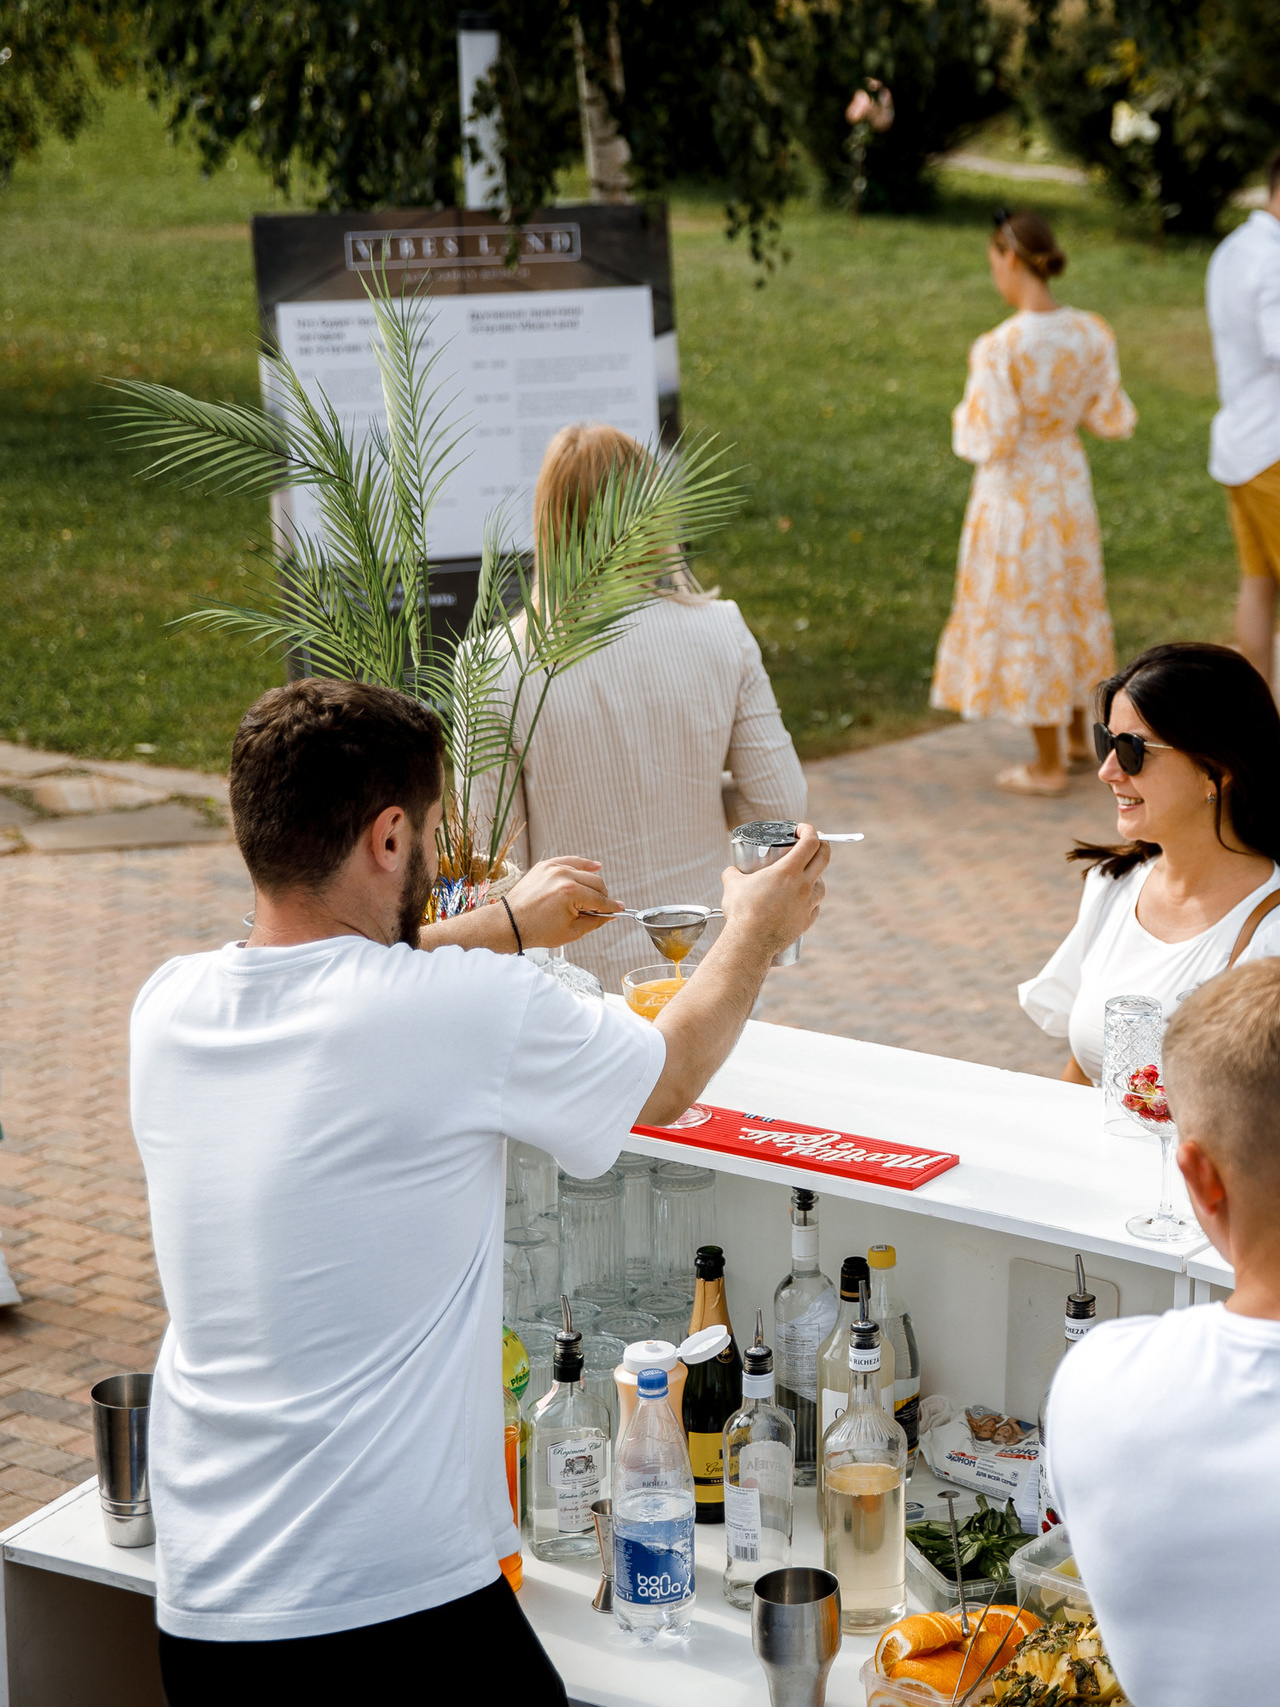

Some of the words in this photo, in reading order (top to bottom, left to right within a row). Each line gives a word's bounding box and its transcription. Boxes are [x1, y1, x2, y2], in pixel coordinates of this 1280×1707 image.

[478, 231, 572, 258] LND
[782, 1146, 952, 1169] Martini
[637, 1572, 671, 1587] bon
[637, 1582, 682, 1599] aqua
